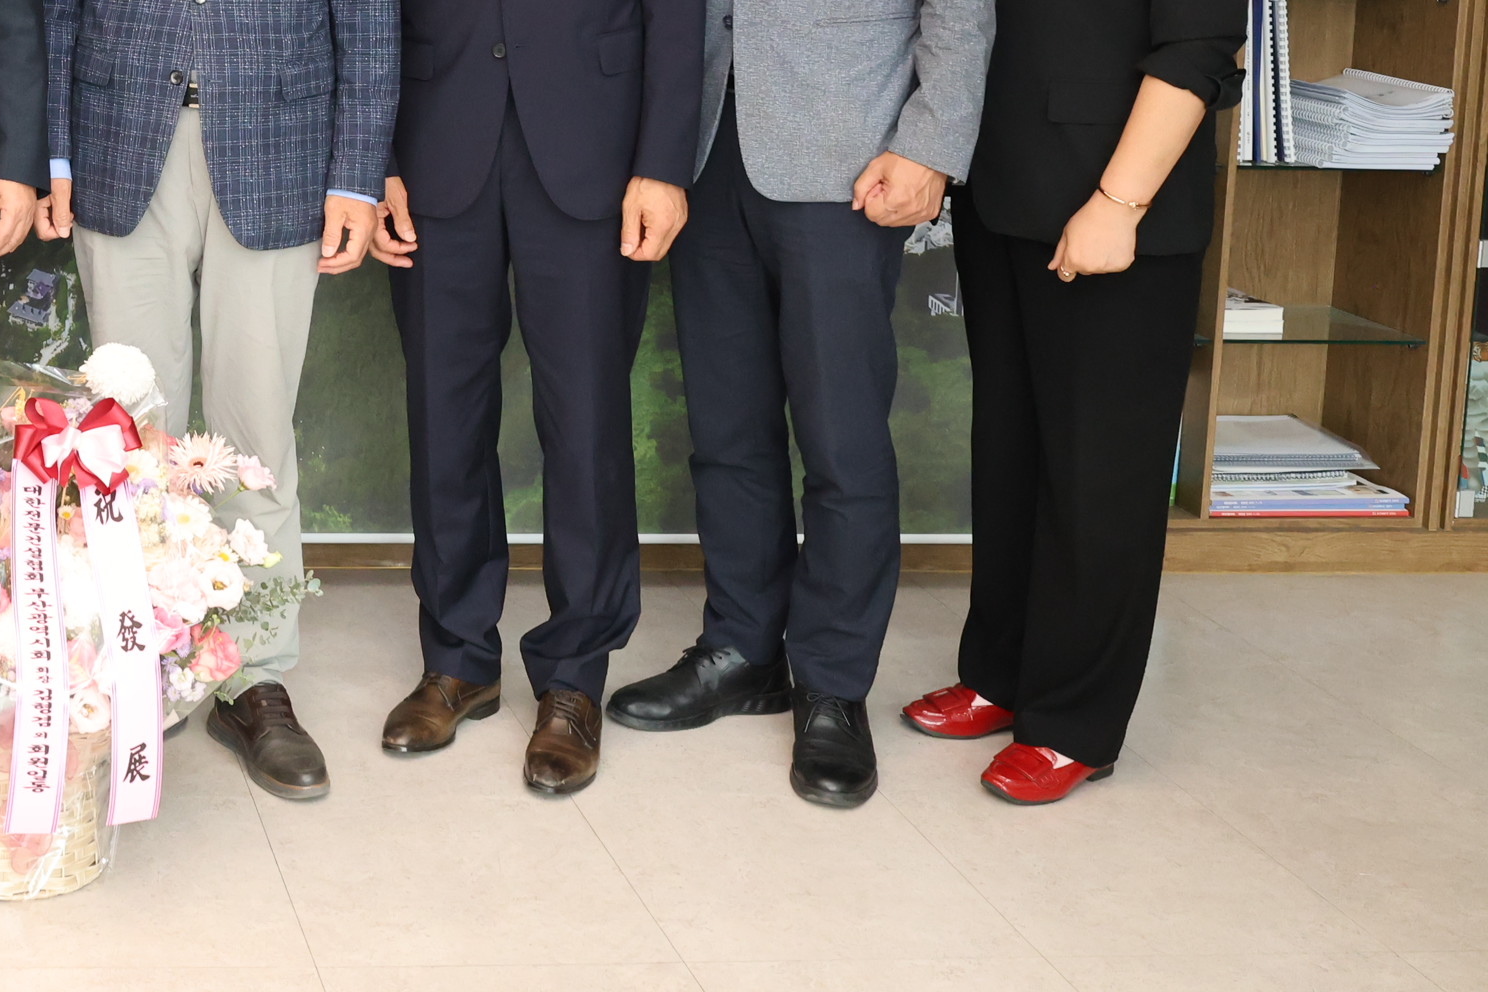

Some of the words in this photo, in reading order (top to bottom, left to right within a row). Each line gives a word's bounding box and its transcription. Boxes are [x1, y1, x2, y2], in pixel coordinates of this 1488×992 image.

[23, 485, 46, 584] 대한전문건설협회
[24, 587, 53, 662] 부산광역시회
[37, 666, 54, 684] 회장
[23, 743, 51, 793] 회원일동
